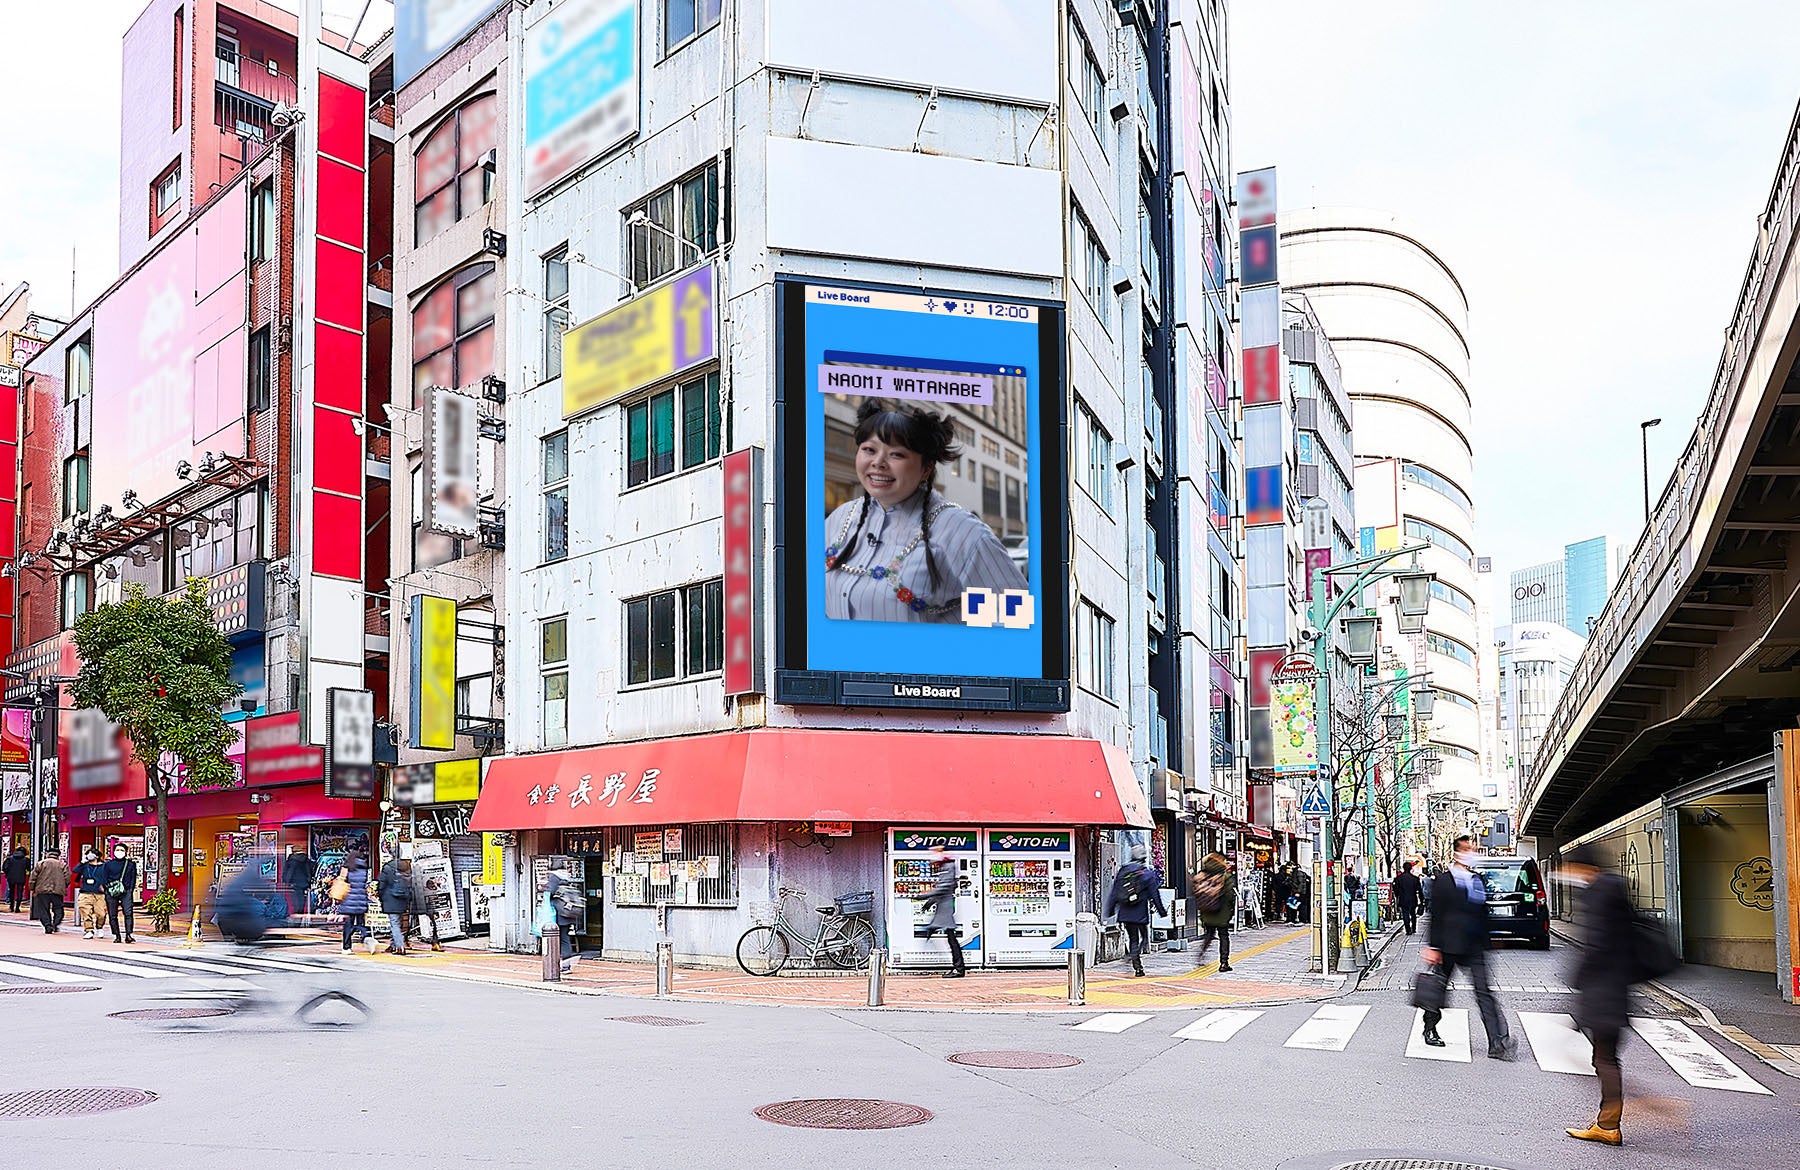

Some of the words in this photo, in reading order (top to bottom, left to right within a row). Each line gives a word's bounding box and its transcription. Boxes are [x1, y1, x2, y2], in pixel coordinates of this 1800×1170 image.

[818, 291, 838, 301] Live
[840, 292, 870, 303] Board
[987, 303, 1029, 319] 12:00
[828, 372, 883, 390] NAOMI
[893, 378, 982, 398] WATANABE
[894, 684, 922, 697] Live
[922, 686, 961, 698] Board
[526, 784, 561, 806] 食堂
[567, 768, 661, 809] 長野屋
[948, 836, 967, 847] EN
[1017, 837, 1041, 848] ITO
[1041, 837, 1060, 848] EN
